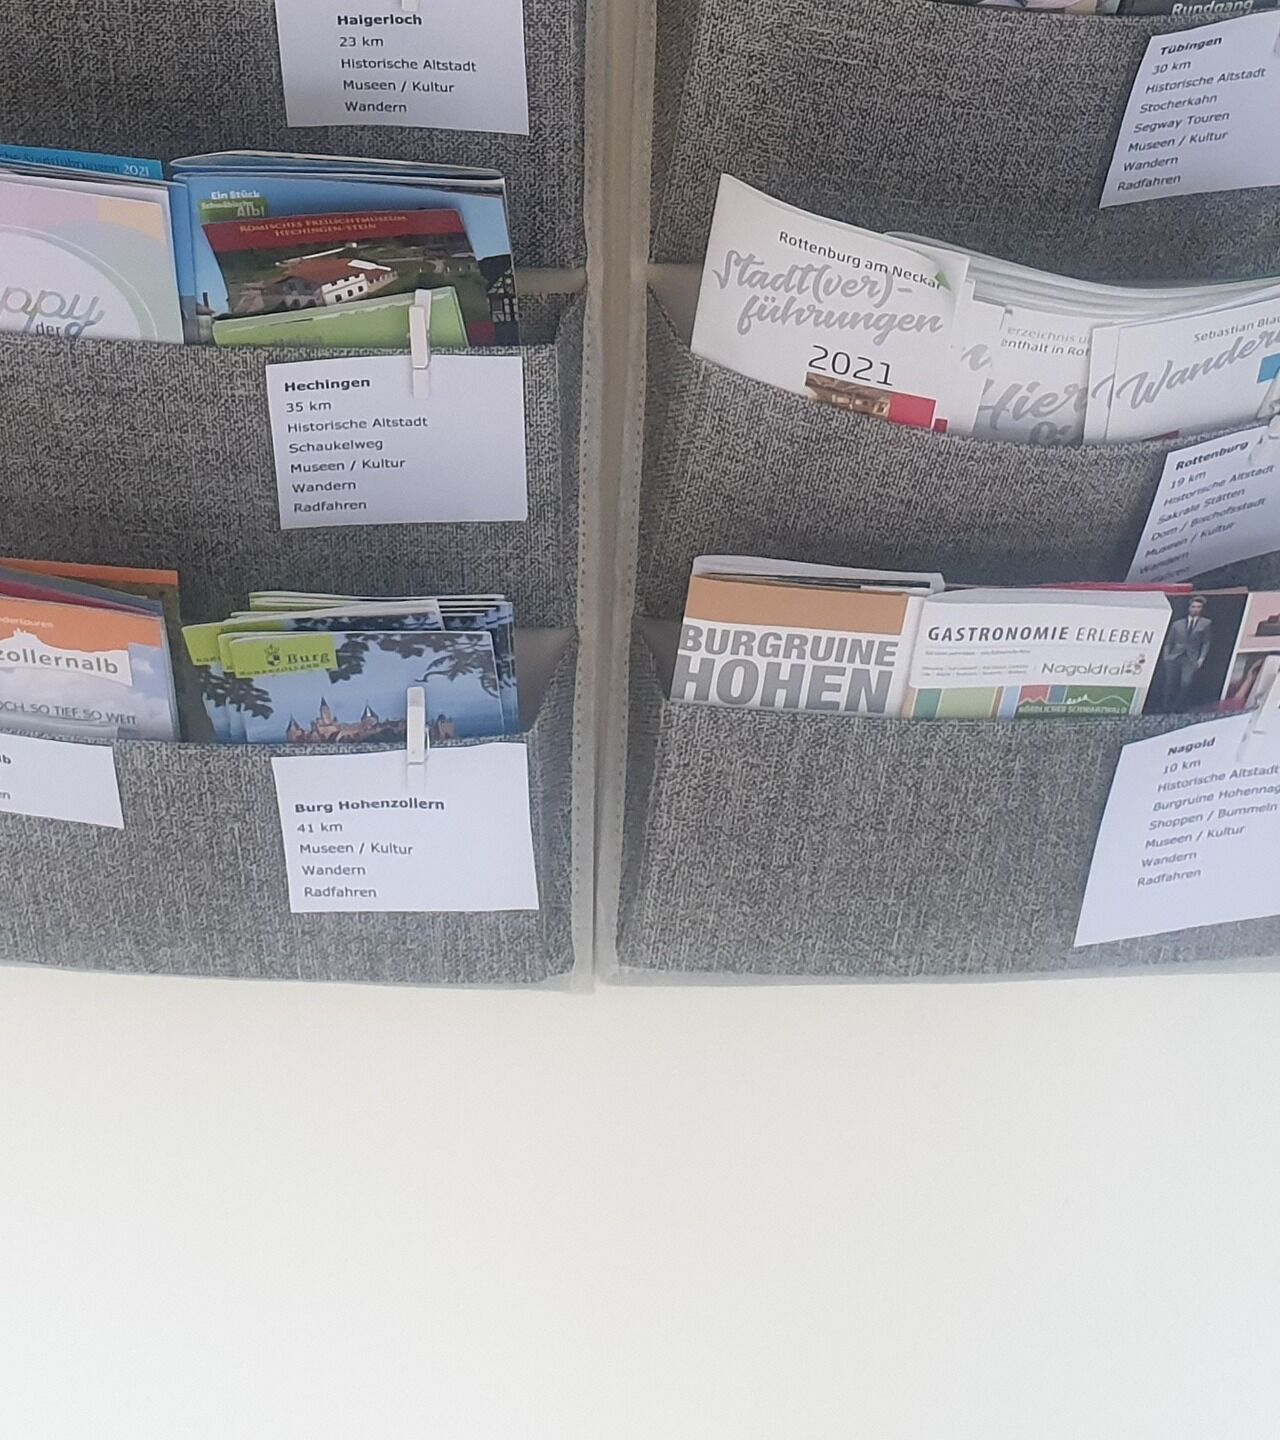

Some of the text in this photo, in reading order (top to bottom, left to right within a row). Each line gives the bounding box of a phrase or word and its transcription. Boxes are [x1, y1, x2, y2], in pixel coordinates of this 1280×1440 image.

[1172, 0, 1254, 15] Rundgang
[337, 15, 422, 27] Haigerloch
[339, 37, 384, 47] 23 km
[1160, 36, 1222, 56] Tübingen
[341, 59, 477, 72] Historische Altstadt
[1152, 60, 1191, 75] 30 km
[343, 80, 396, 91] Museen
[412, 82, 455, 93] Kultur
[1146, 67, 1267, 94] Historische Altstadt
[345, 102, 407, 112] Wandern
[1139, 94, 1217, 114] Stocherkahn
[1133, 111, 1230, 133] Segway Touren
[1128, 137, 1175, 152] Museen
[1189, 130, 1228, 144] Kultur
[1123, 156, 1178, 172] Wandern
[1117, 174, 1181, 191] Radfahren
[211, 190, 260, 199] Ein Stück
[779, 230, 942, 290] Rottenburg am Neckar
[737, 295, 943, 346] führungen
[1193, 324, 1255, 344] Sebastian
[807, 344, 894, 386] 2021
[284, 378, 370, 392] Hechingen
[286, 400, 331, 412] 35 km
[287, 417, 428, 433] Historische Altstadt
[289, 440, 384, 454] Schaukelweg
[1175, 440, 1249, 470] Rottenburg
[291, 461, 345, 473] Museen
[362, 459, 406, 469] Kultur
[292, 481, 356, 493] Wandern
[1163, 465, 1275, 507] Historische Altstadt
[294, 500, 367, 512] Radfahren
[928, 626, 1154, 644] GASTRONOMIE ERLEBEN
[679, 622, 899, 667] BURGRUINE
[287, 653, 330, 664] Burg
[1041, 663, 1125, 676] Nagoldtal
[670, 654, 894, 713] HOHEN
[1167, 737, 1216, 756] Nagold
[1163, 759, 1201, 775] 10 km
[1157, 765, 1280, 792] Historische Altstadt
[295, 797, 445, 814] Burg Hohenzollern
[1153, 793, 1214, 813] Burgruine
[1148, 813, 1204, 831] Shoppen
[1218, 802, 1278, 819] Bummeln
[297, 822, 343, 833] 41 km
[1145, 833, 1193, 849] Museen
[1207, 825, 1246, 839] Kultur
[299, 843, 354, 854] Museen
[371, 843, 413, 854] Kultur
[1141, 851, 1197, 868] Wandern
[302, 865, 366, 875] Wandern
[1137, 869, 1201, 887] Radfahren
[304, 886, 377, 898] Radfahren
